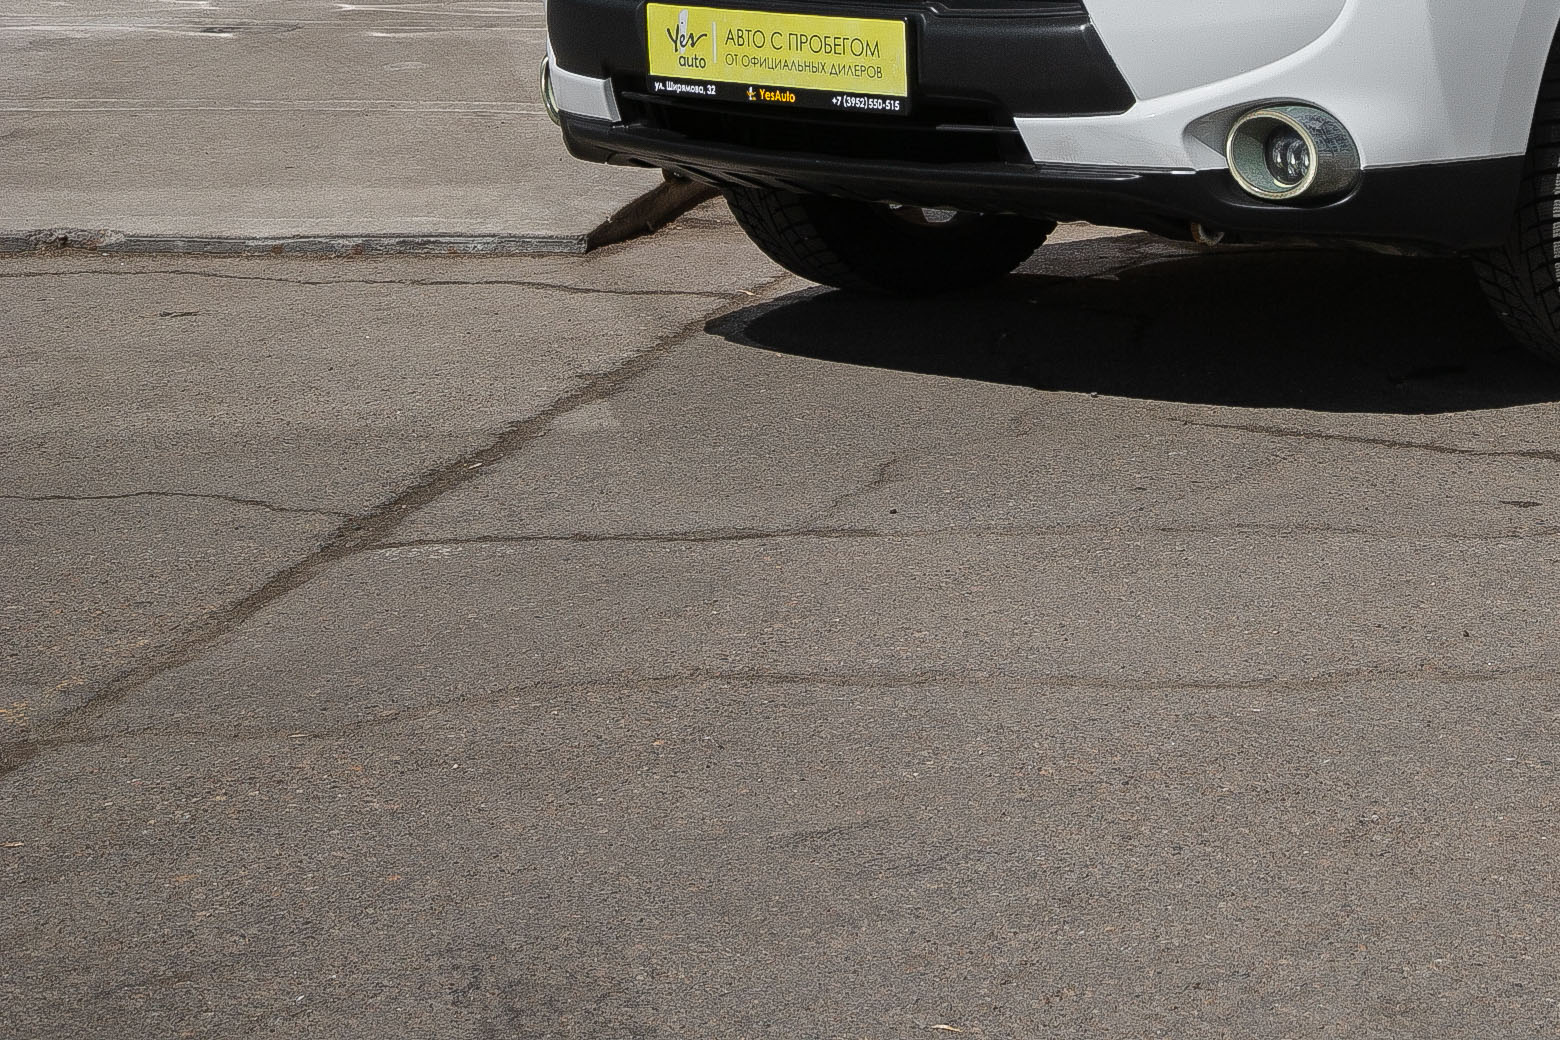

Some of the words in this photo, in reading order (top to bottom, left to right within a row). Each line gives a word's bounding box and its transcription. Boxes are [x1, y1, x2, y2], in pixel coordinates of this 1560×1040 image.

[725, 28, 766, 48] АВТО
[770, 31, 783, 50] С
[788, 32, 881, 58] ПРОБЕГОМ
[678, 54, 707, 69] auto
[725, 54, 739, 67] ОТ
[741, 55, 827, 75] ОФИЦИАЛЬНЫХ
[829, 62, 883, 79] ДИЛЕРОВ
[654, 81, 665, 92] ул.
[706, 85, 716, 95] 32
[759, 88, 796, 103] YesAuto
